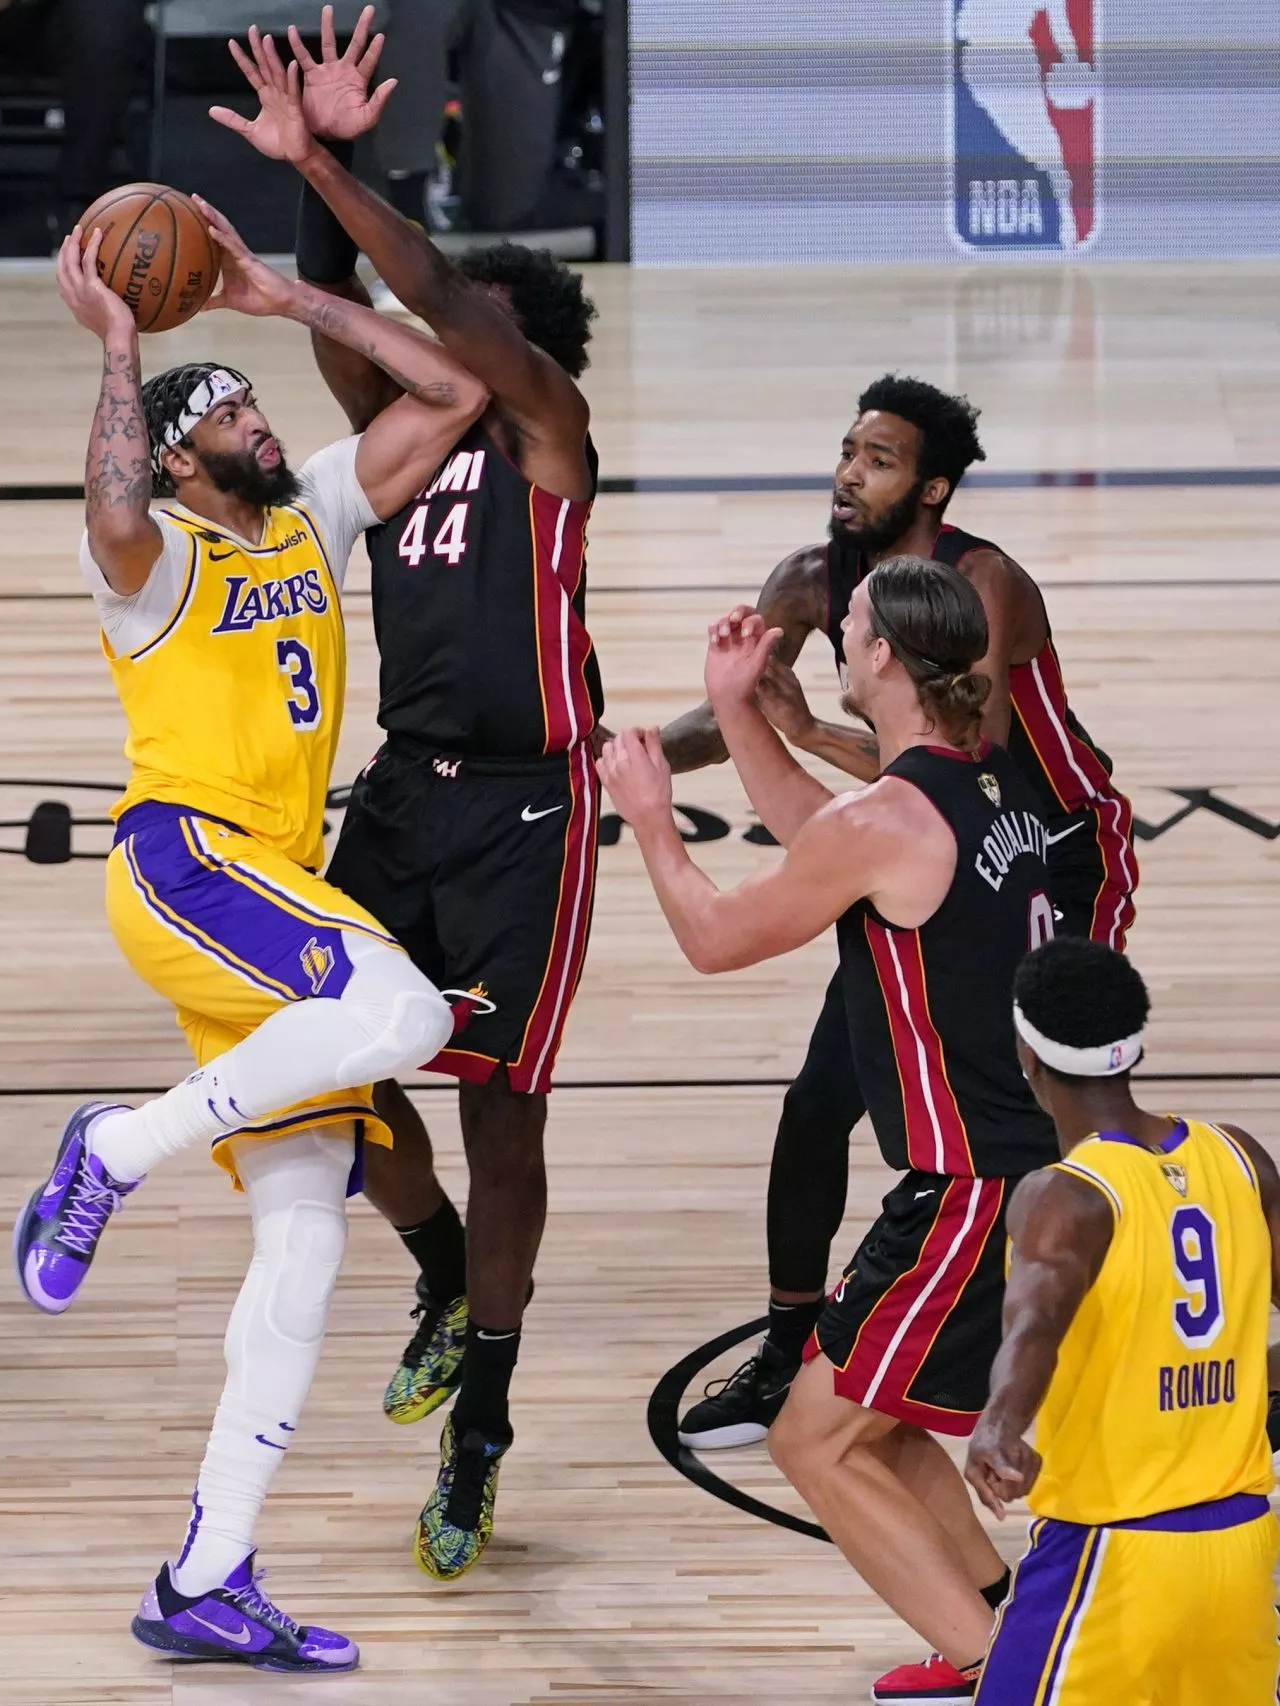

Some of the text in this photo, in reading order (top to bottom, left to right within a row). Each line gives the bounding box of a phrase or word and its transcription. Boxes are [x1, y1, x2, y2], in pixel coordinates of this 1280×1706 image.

[968, 180, 1043, 234] NBA
[274, 529, 308, 553] wish
[398, 503, 470, 566] 44
[275, 637, 322, 730] 3
[974, 811, 1049, 892] EQUALITY
[1171, 1204, 1224, 1347] 9
[1159, 1358, 1236, 1412] RONDO
